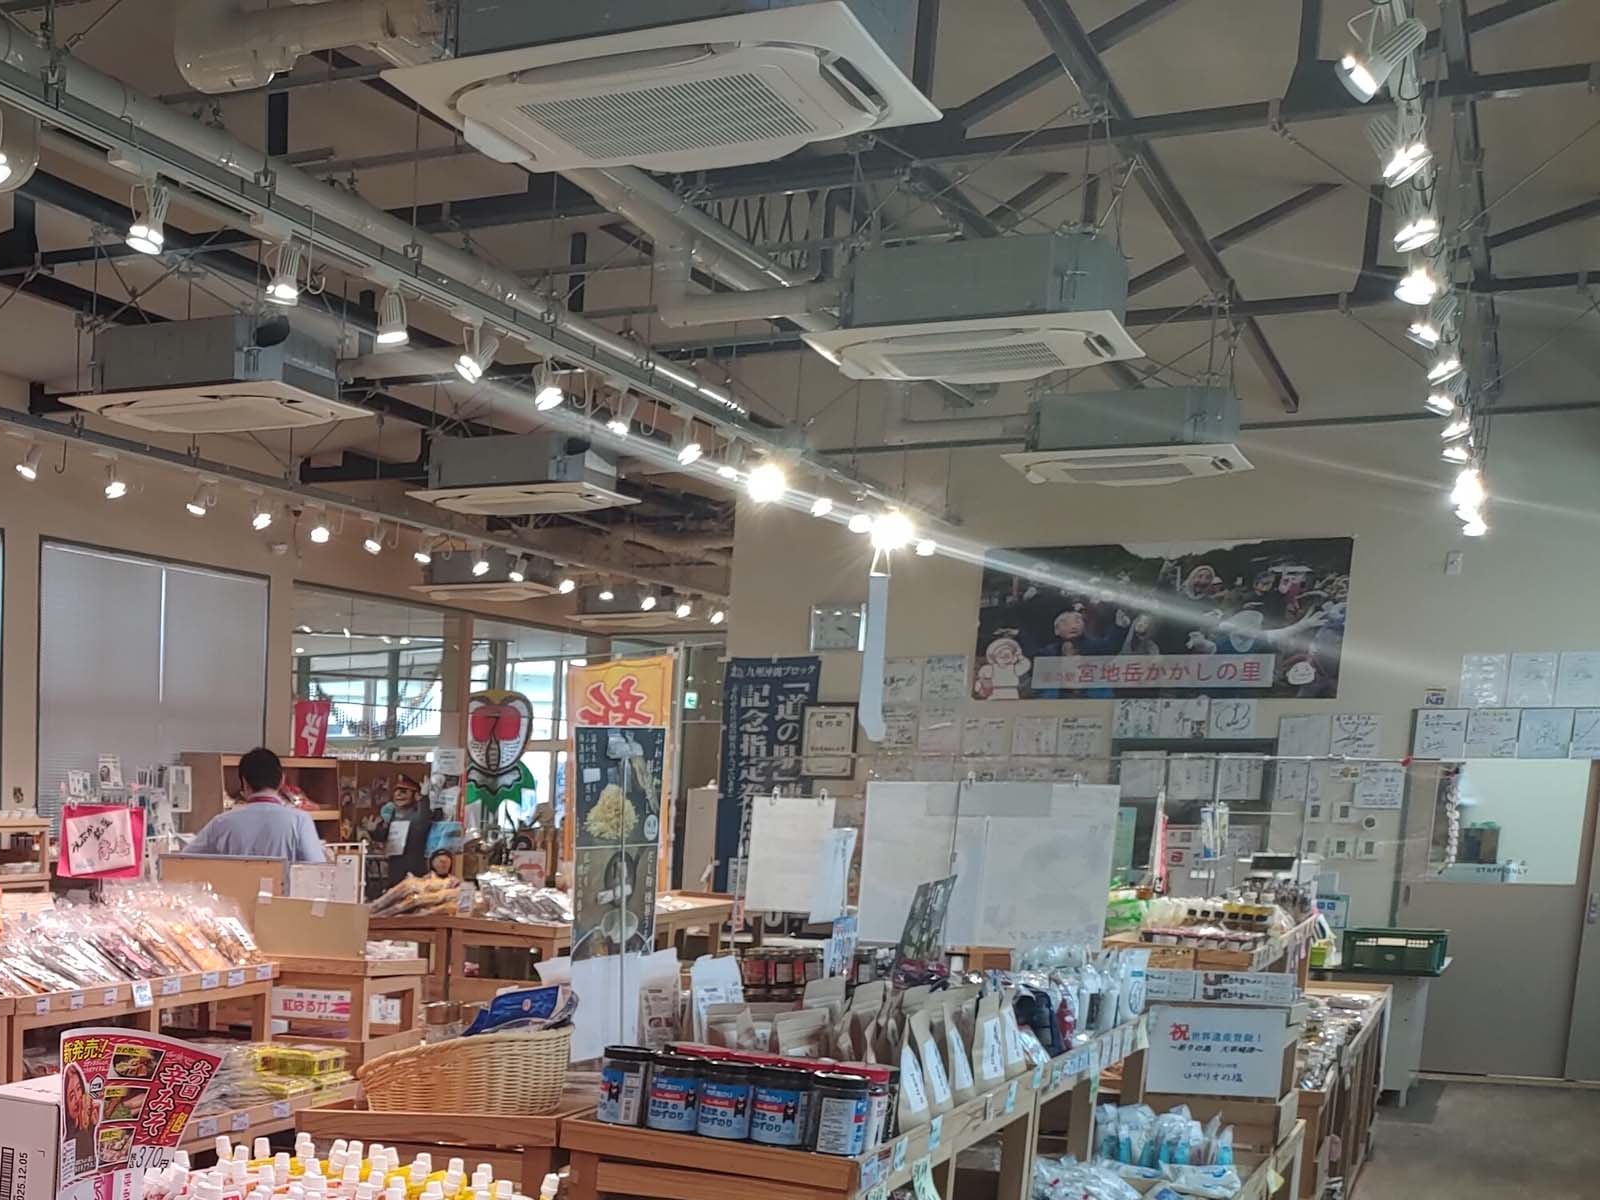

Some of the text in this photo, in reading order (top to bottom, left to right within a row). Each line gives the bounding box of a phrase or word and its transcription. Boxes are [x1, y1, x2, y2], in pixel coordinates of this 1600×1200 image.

[746, 665, 816, 678] 九州沖縄ブロック
[1078, 662, 1261, 682] 宮地岳かかしの里
[1169, 1023, 1190, 1041] 祝
[179, 1060, 212, 1099] 火の国
[142, 1064, 189, 1137] 辛みそ
